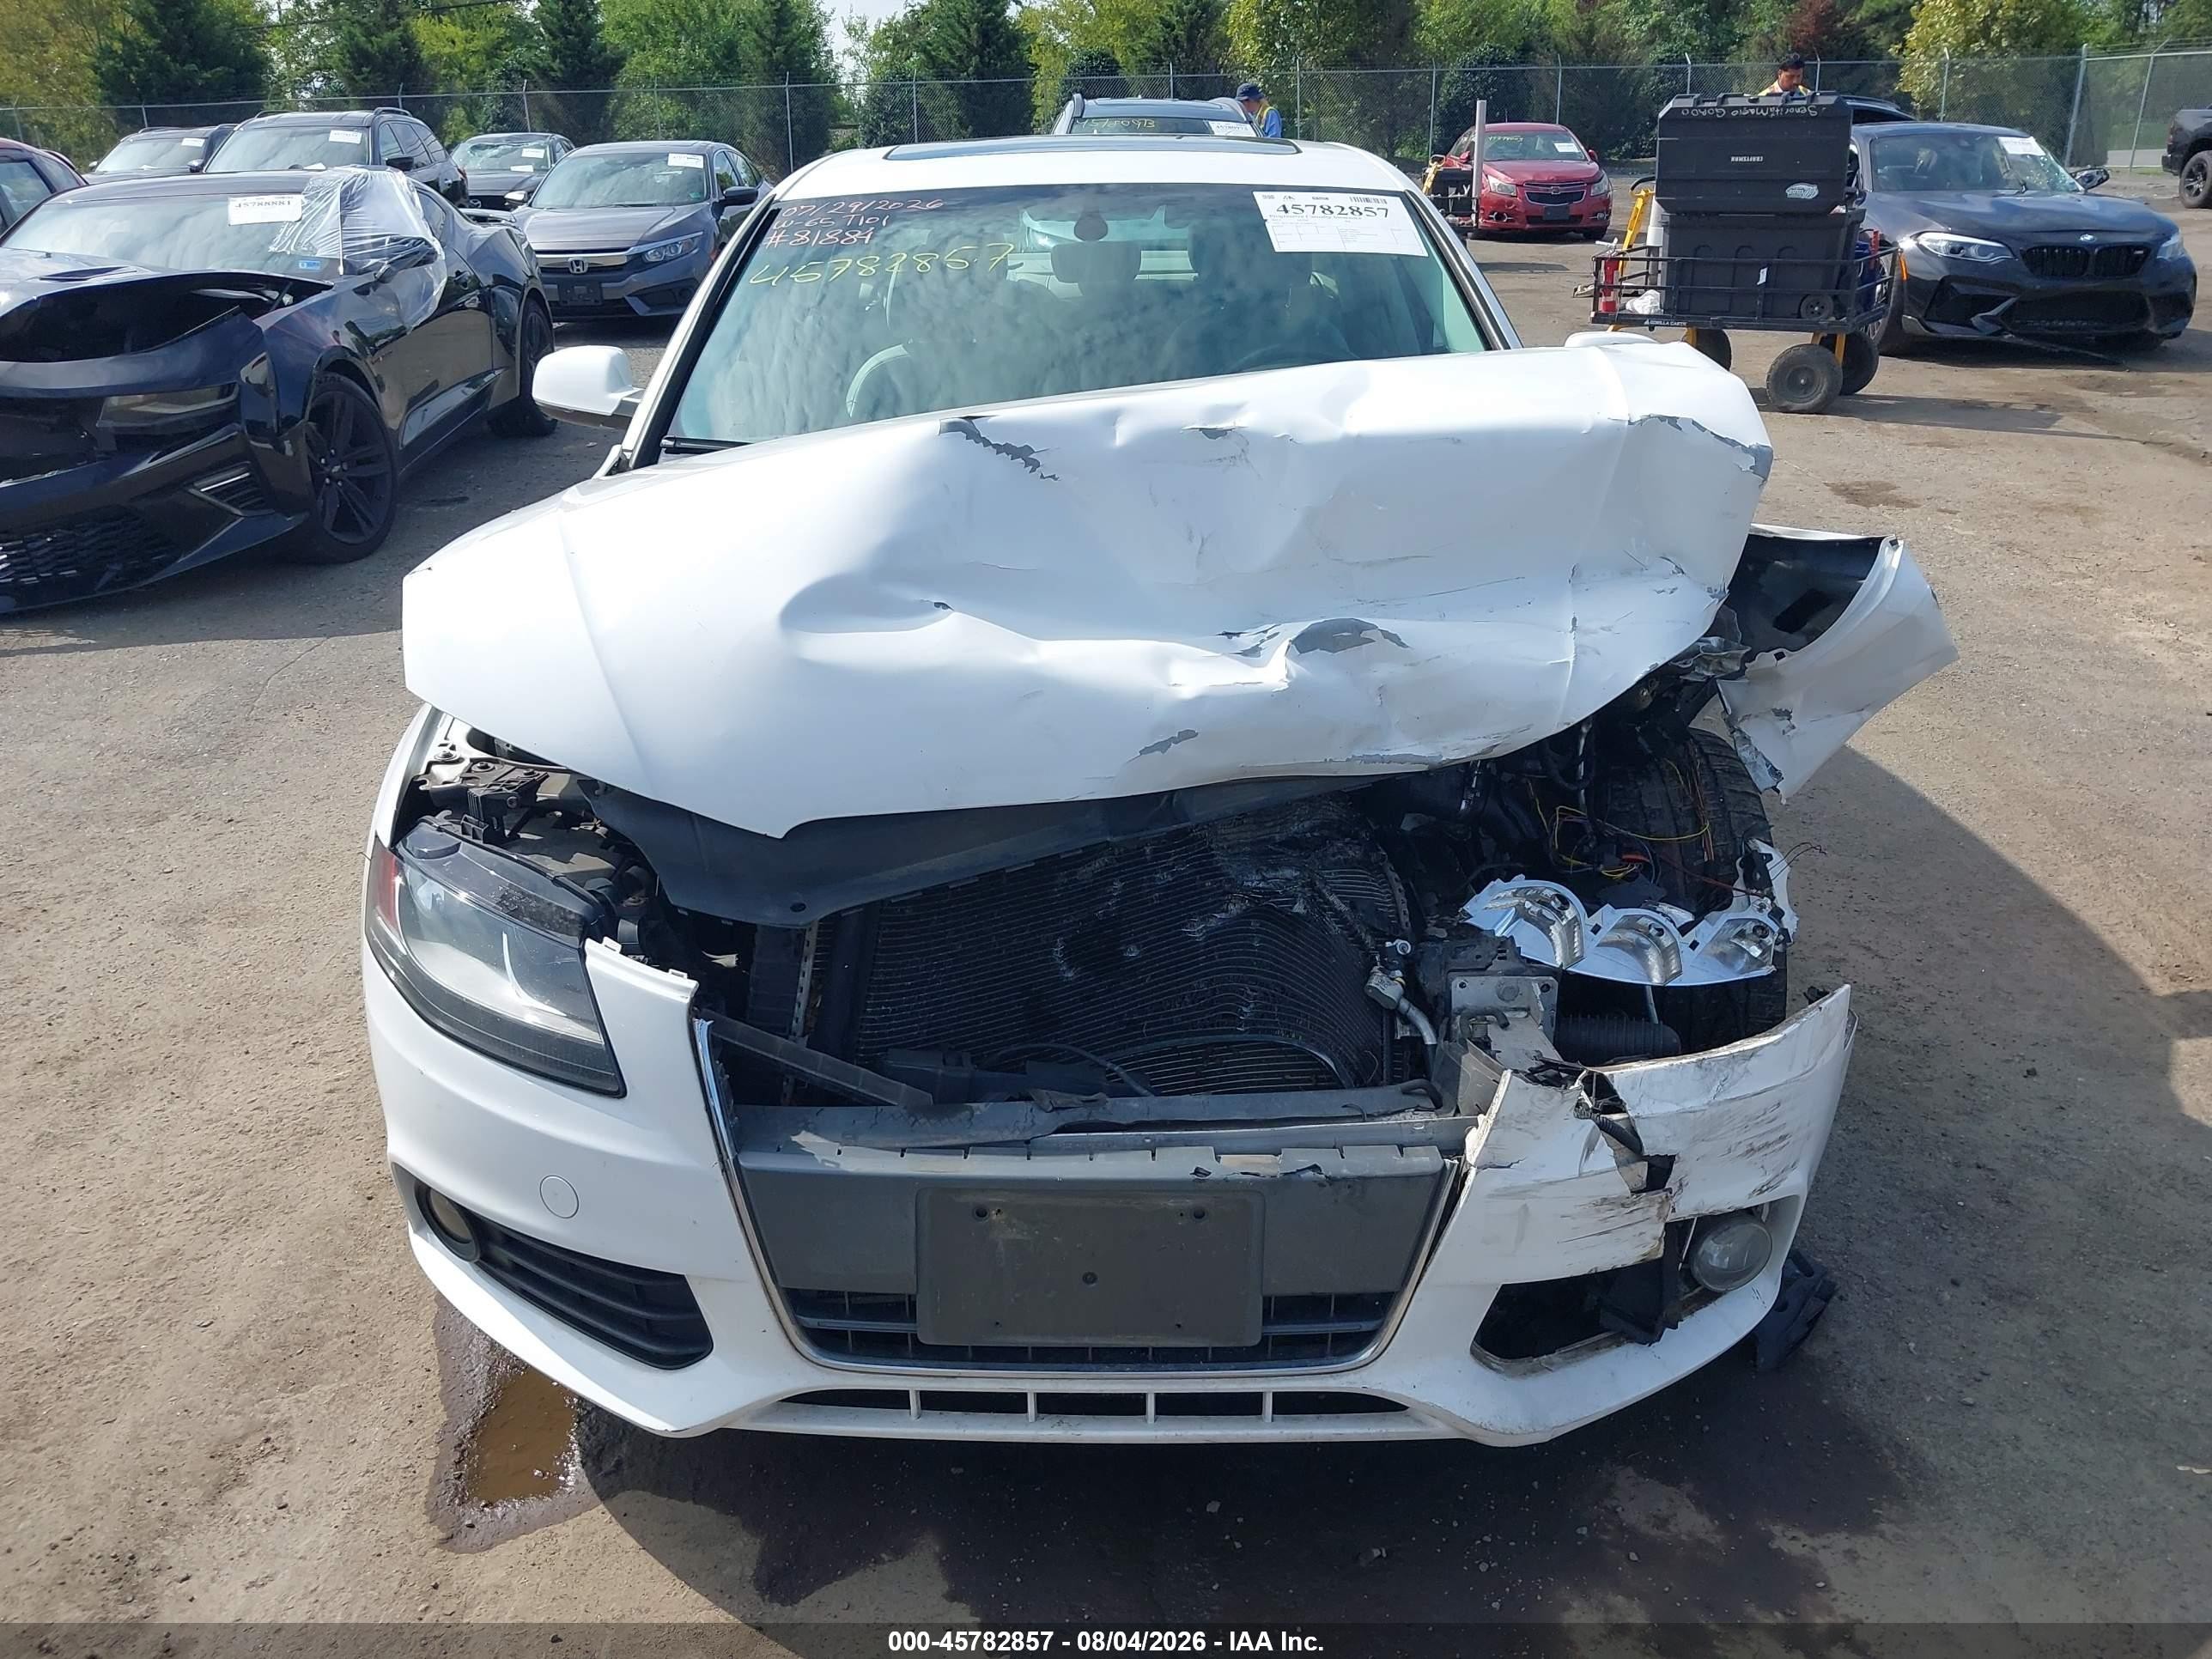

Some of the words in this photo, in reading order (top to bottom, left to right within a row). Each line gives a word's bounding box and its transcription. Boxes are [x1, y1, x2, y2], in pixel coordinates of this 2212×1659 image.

[782, 198, 944, 217] 07/29/2026
[1276, 204, 1389, 218] 45782857
[749, 243, 1015, 286] 45782857
